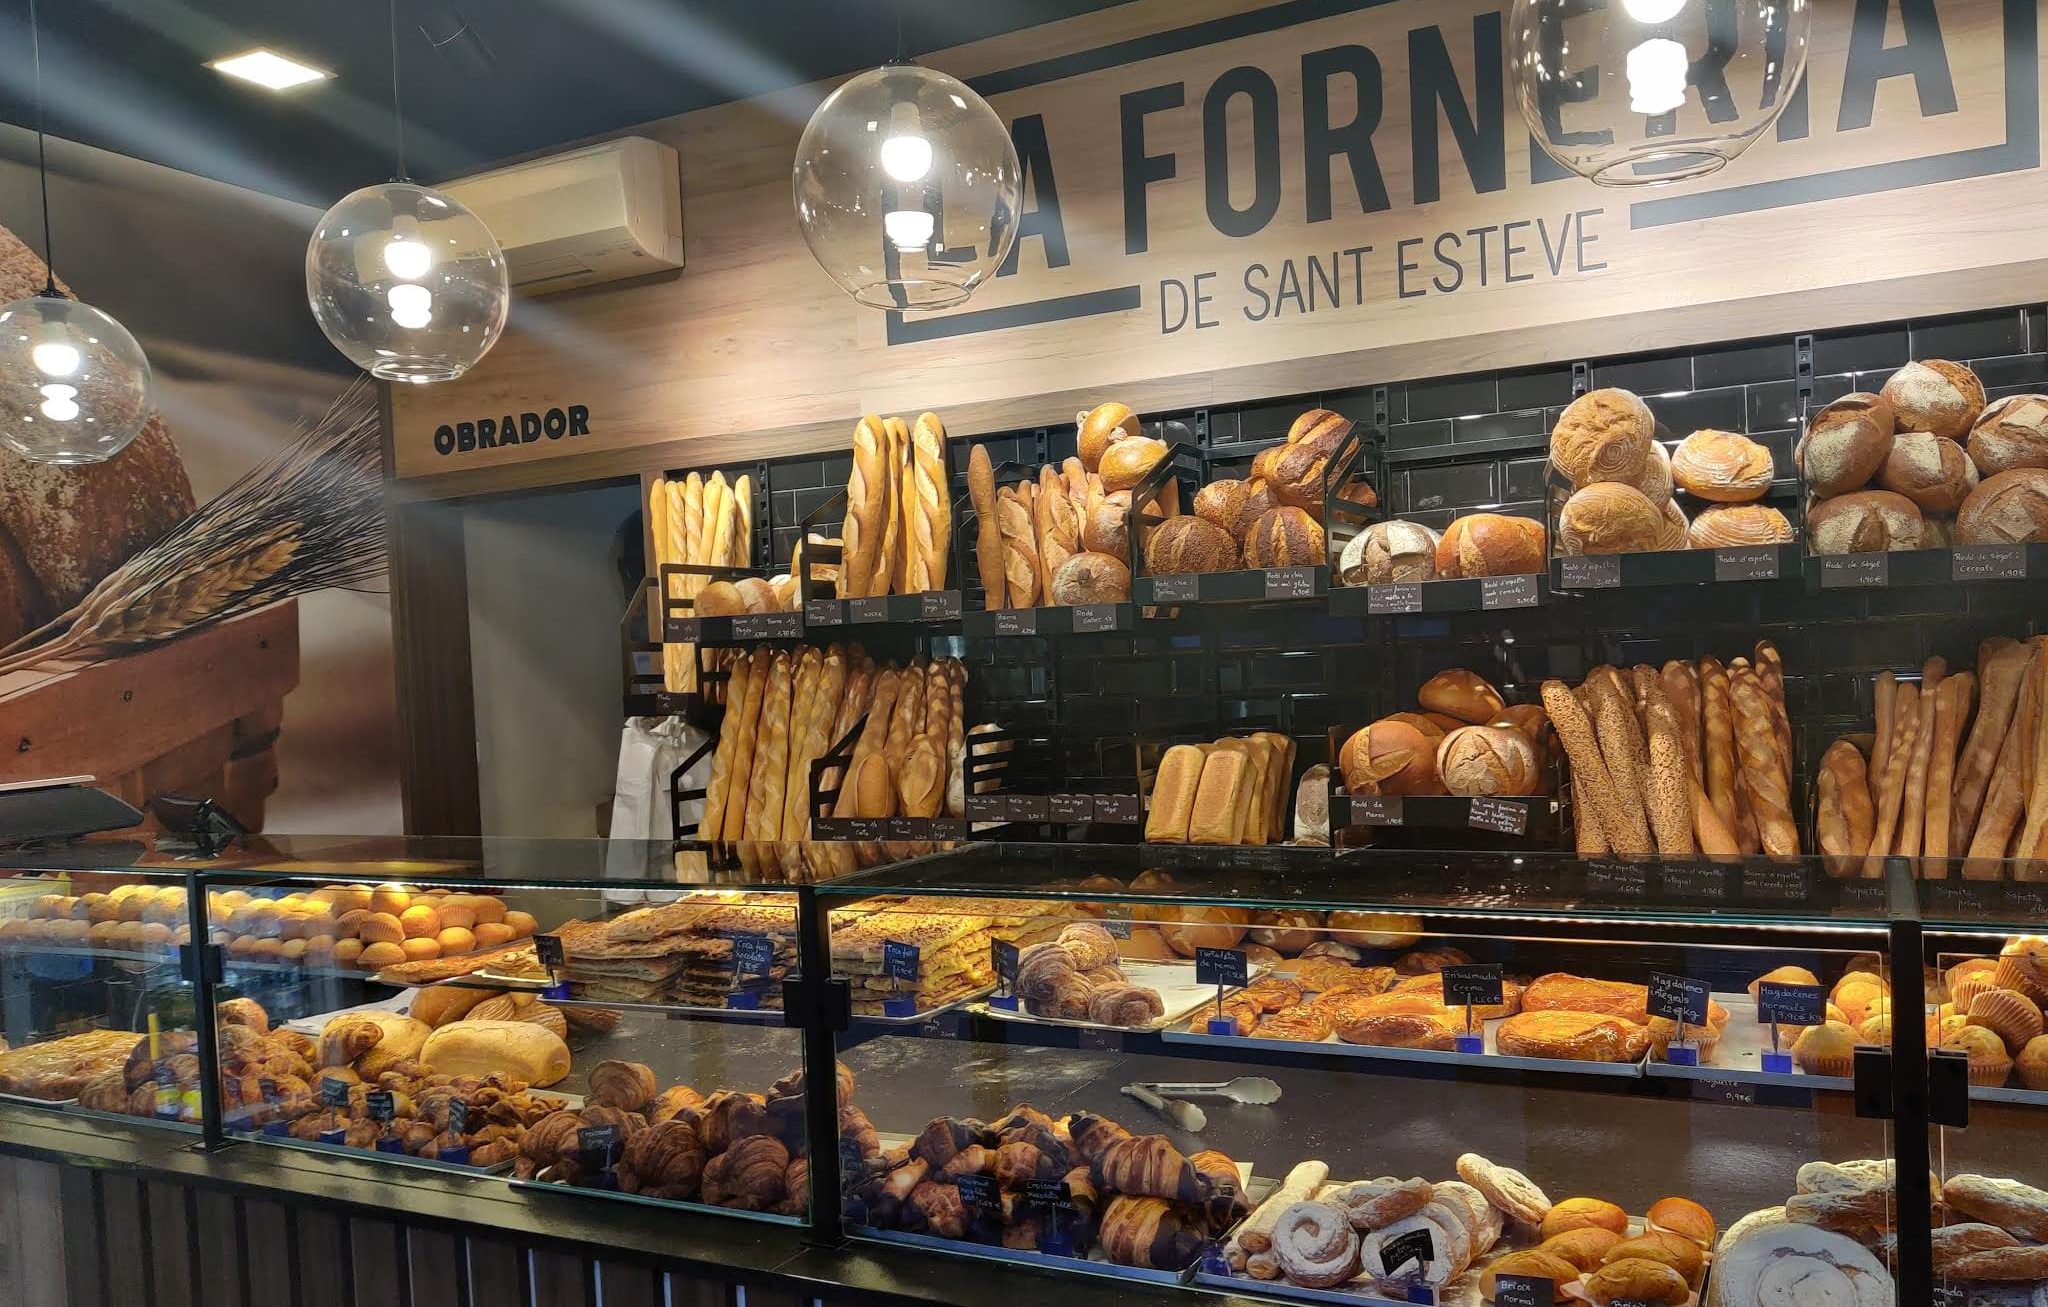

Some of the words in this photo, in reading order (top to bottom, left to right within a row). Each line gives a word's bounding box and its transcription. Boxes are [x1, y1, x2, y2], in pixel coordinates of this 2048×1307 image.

[1160, 271, 1221, 335] DE
[1243, 245, 1374, 323] SANT
[1398, 208, 1608, 299] ESTEVE
[434, 404, 590, 456] OBRADOR
[1200, 959, 1211, 967] de
[1503, 1294, 1535, 1306] normal
